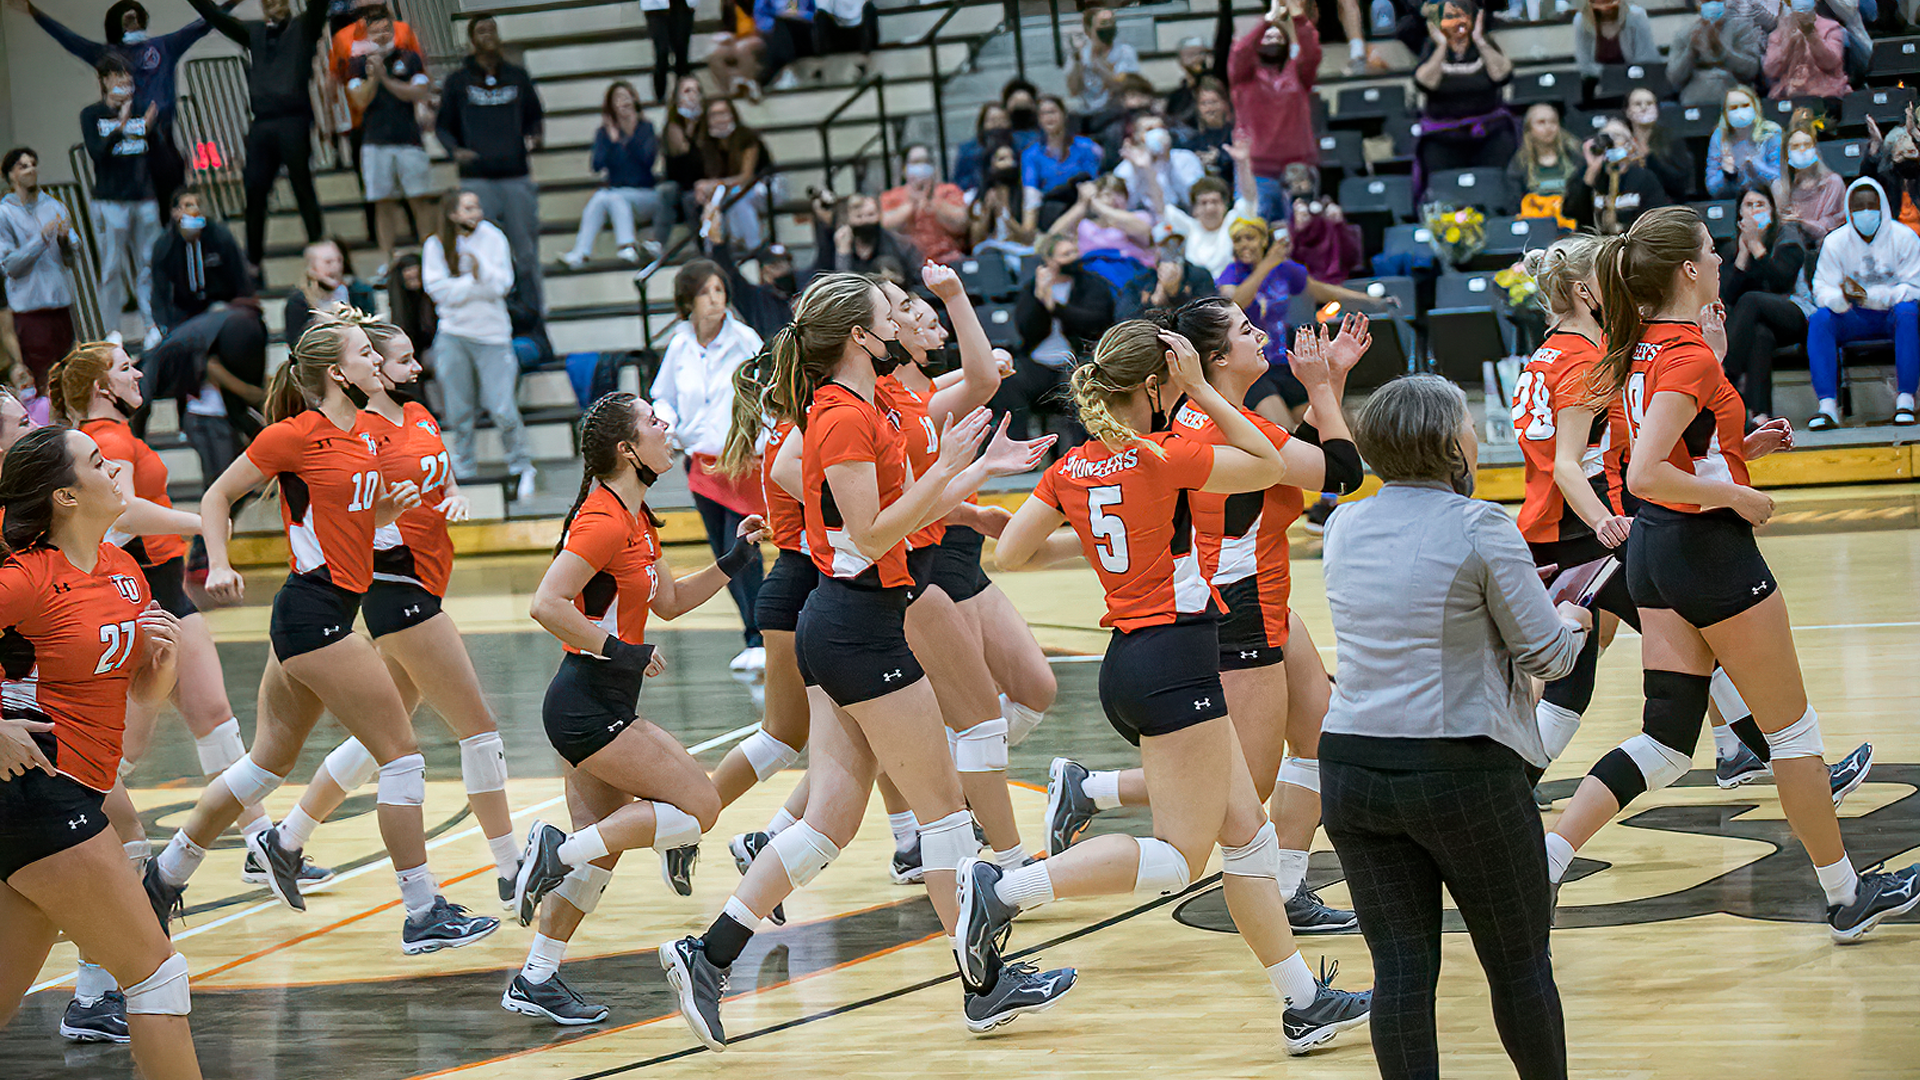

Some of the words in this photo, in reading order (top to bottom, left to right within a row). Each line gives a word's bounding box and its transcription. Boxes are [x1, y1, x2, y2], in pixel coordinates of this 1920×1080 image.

[348, 471, 378, 512] 10
[1087, 484, 1130, 573] 5
[108, 574, 142, 604] TU
[93, 620, 136, 675] 27
